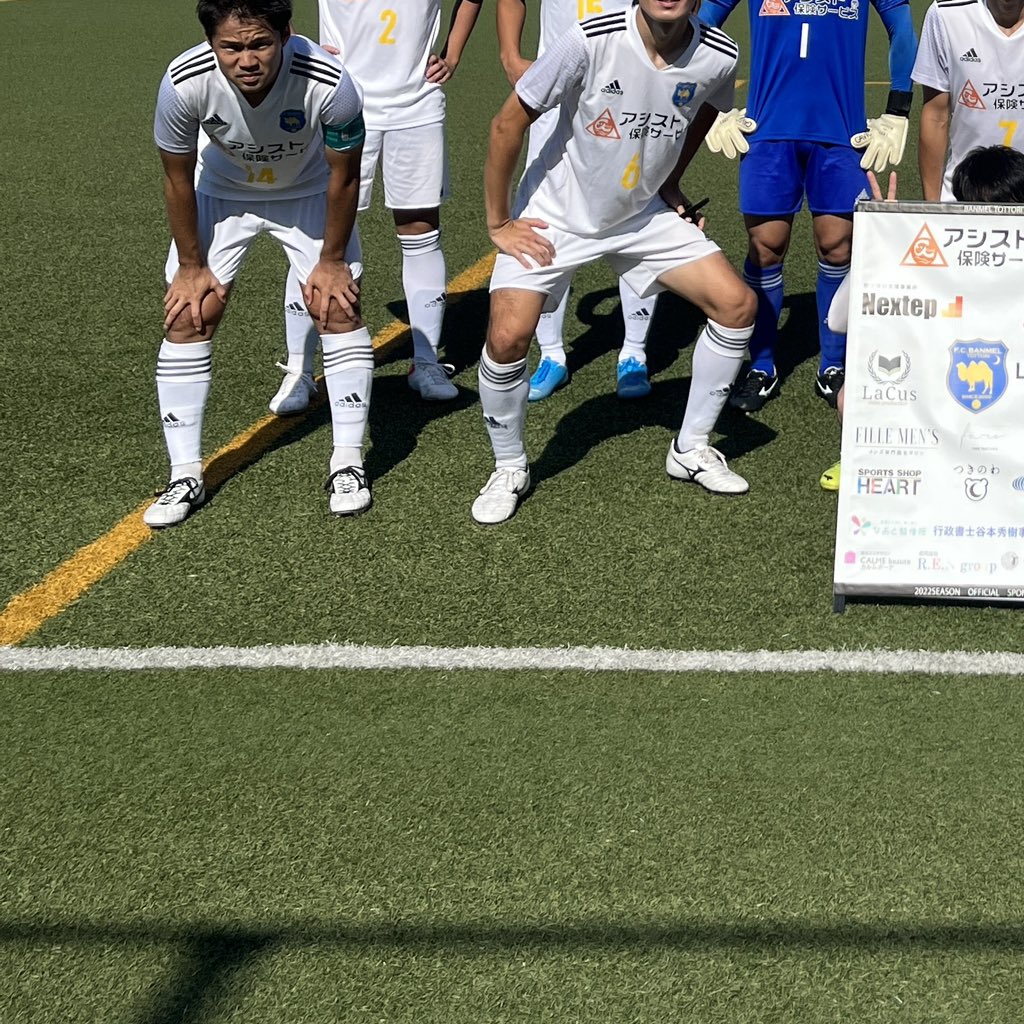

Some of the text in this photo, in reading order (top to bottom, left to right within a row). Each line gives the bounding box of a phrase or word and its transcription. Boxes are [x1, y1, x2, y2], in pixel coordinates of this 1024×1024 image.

[794, 3, 859, 20] 保険サービス
[378, 9, 398, 46] 2
[800, 22, 810, 59] 1
[960, 56, 982, 64] adidas
[601, 87, 624, 96] adidas
[619, 112, 681, 129] アシスト
[998, 119, 1019, 151] 7
[226, 140, 305, 155] アシスト
[964, 205, 1023, 214] BANMEL TOTTORI
[861, 292, 938, 320] Nextep
[968, 347, 1003, 355] BANMEL
[862, 386, 918, 401] LaCus
[856, 427, 939, 446] FILLE MEN'S
[953, 464, 1000, 475] つきのわ
[857, 478, 922, 495] HEART
[914, 587, 961, 596] 2022SEASON
[968, 587, 999, 596] OFFICIAL
